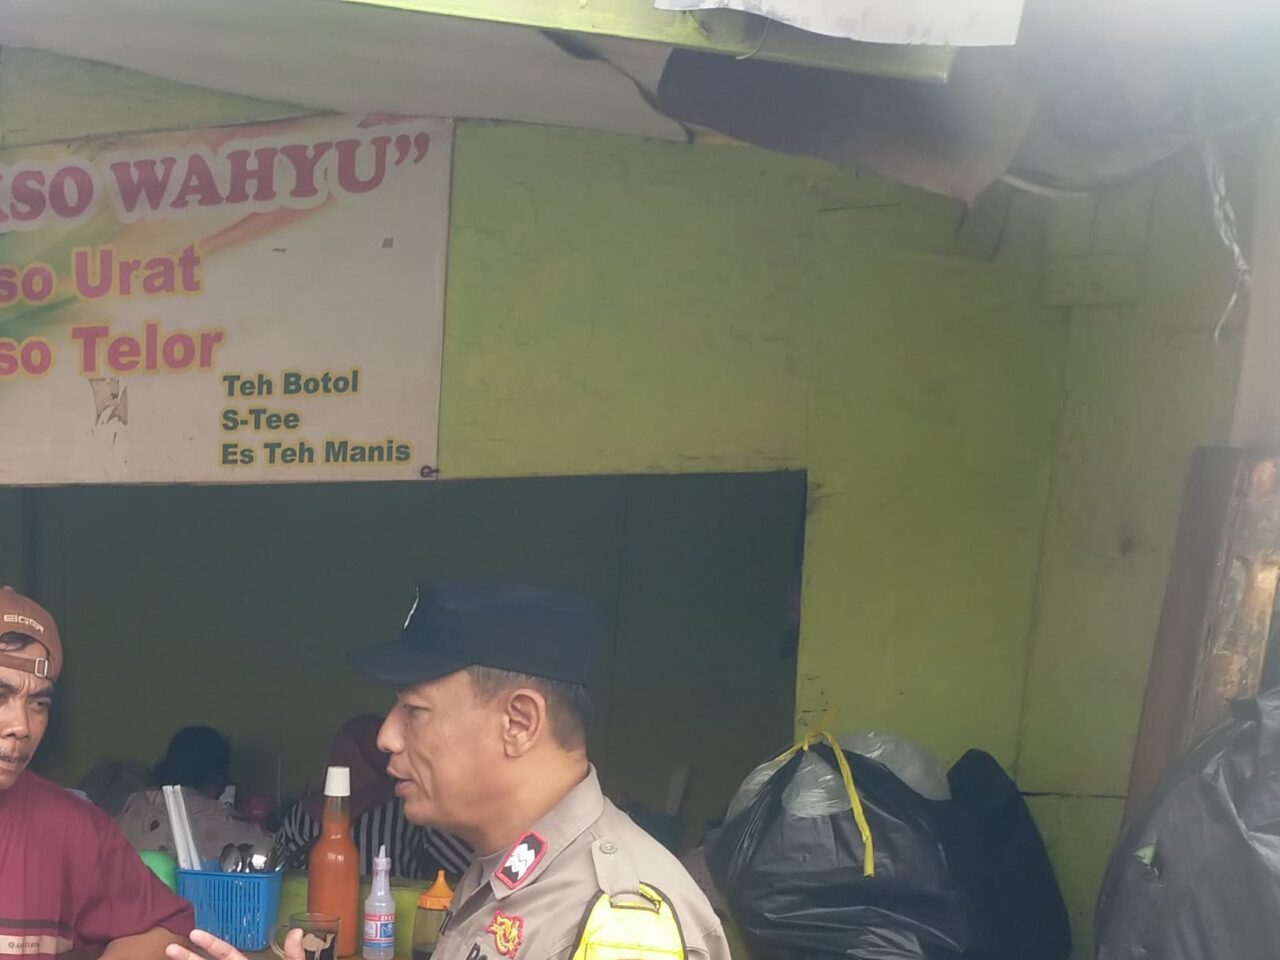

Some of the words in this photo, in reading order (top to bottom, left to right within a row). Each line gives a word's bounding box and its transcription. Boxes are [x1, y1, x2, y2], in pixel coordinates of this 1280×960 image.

[73, 245, 201, 297] Urat
[72, 325, 224, 373] Telor
[223, 374, 274, 397] Teh
[283, 370, 359, 395] Botol
[221, 408, 300, 431] S-Tee
[221, 443, 255, 465] Es
[264, 443, 314, 464] Teh
[324, 440, 411, 464] Manis
